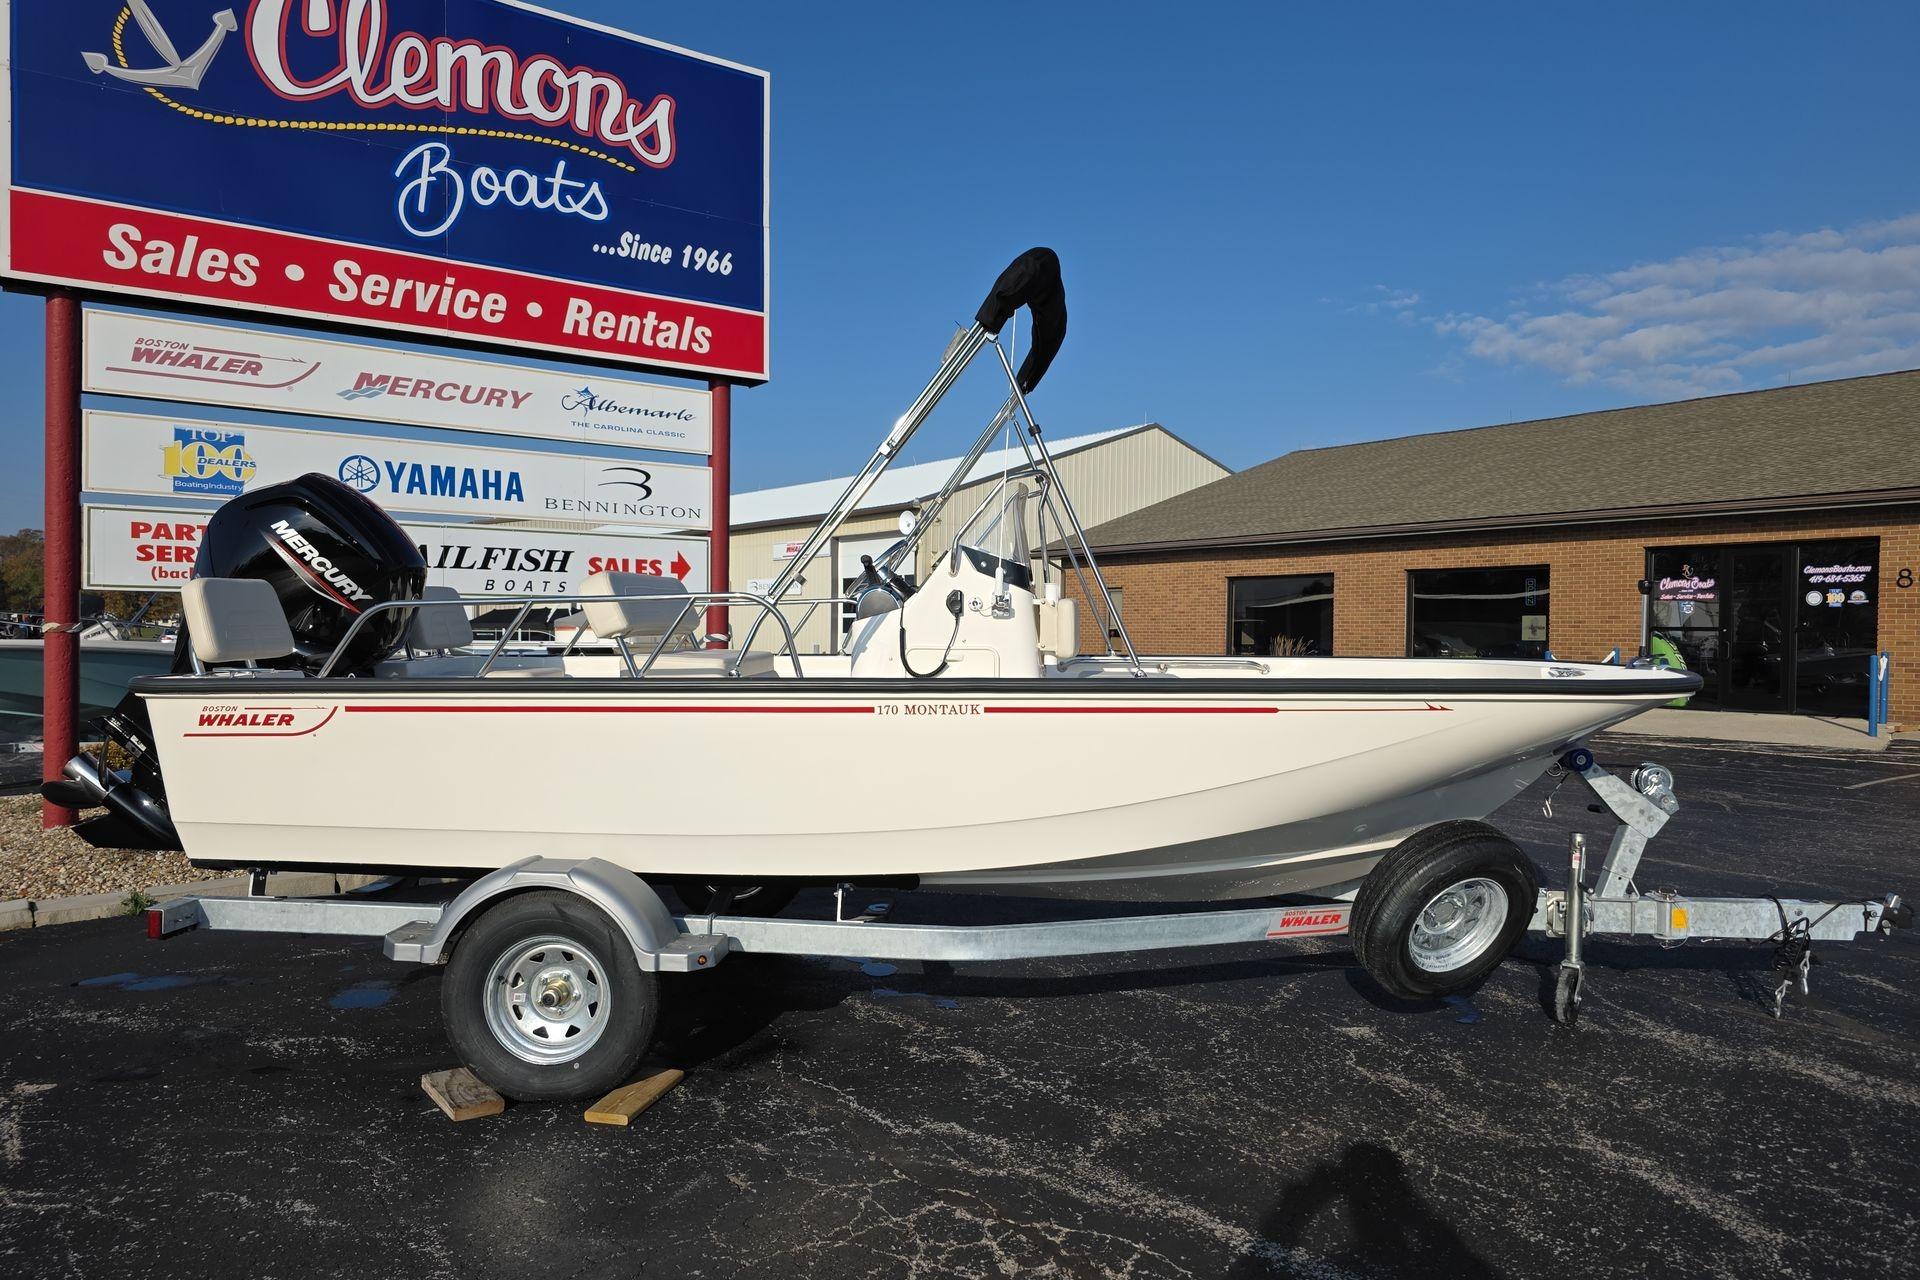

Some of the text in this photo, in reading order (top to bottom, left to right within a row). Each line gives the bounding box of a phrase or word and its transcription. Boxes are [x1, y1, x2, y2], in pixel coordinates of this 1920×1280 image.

[245, 0, 677, 168] Clemons
[394, 141, 609, 238] Boats
[680, 245, 734, 276] 1966
[102, 222, 713, 355] Sales Service Rentals
[135, 337, 189, 350] BOSTON
[130, 346, 263, 376] WHALER
[352, 372, 533, 409] MERCURY
[561, 394, 697, 422] Albemarle
[185, 427, 236, 443] TOP
[570, 420, 686, 439] THE CAROLINA CLASSIC
[159, 440, 257, 483] 100
[198, 457, 257, 468] DEALERS
[384, 460, 525, 502] YAMAHA
[544, 497, 702, 520] BENNINGTON
[131, 521, 209, 541] PART
[136, 544, 200, 563] SER
[270, 519, 374, 601] MERCURY
[416, 543, 576, 574] AILFISH
[587, 555, 663, 577] SALES
[484, 579, 568, 593] BOATS
[1660, 577, 1715, 590] Clemons Boats
[1808, 574, 1866, 583] 419-684-5365
[1896, 568, 1914, 589] 8
[198, 713, 295, 726] WHALER
[877, 703, 981, 716] 170 MONTAUK
[1280, 914, 1342, 928] WHALER
